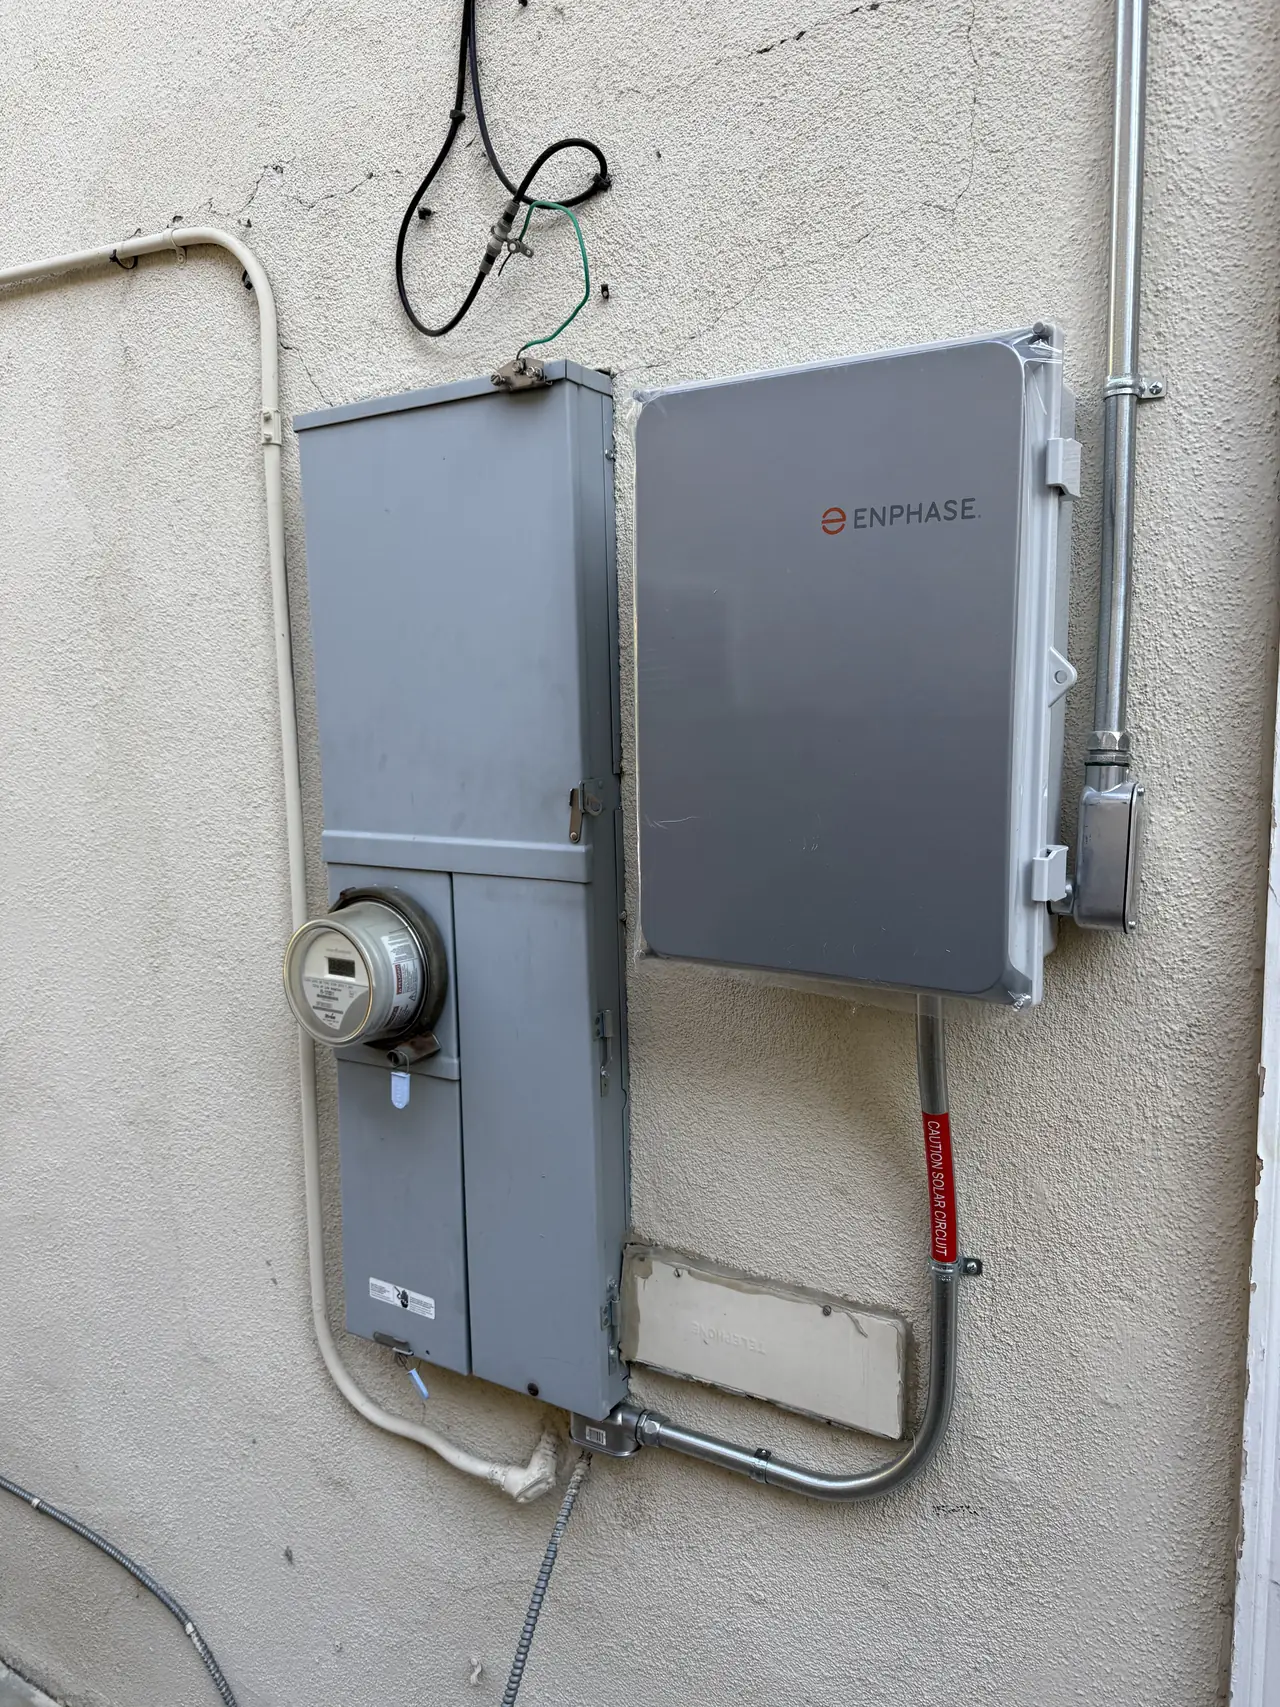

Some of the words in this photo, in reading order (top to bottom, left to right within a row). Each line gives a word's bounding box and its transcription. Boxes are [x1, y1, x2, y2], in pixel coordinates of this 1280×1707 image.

[927, 1120, 943, 1170] CAUTION
[932, 1172, 946, 1208] SOLAR
[934, 1210, 948, 1257] CIRCUIT
[690, 1321, 767, 1356] TELEPHONE
